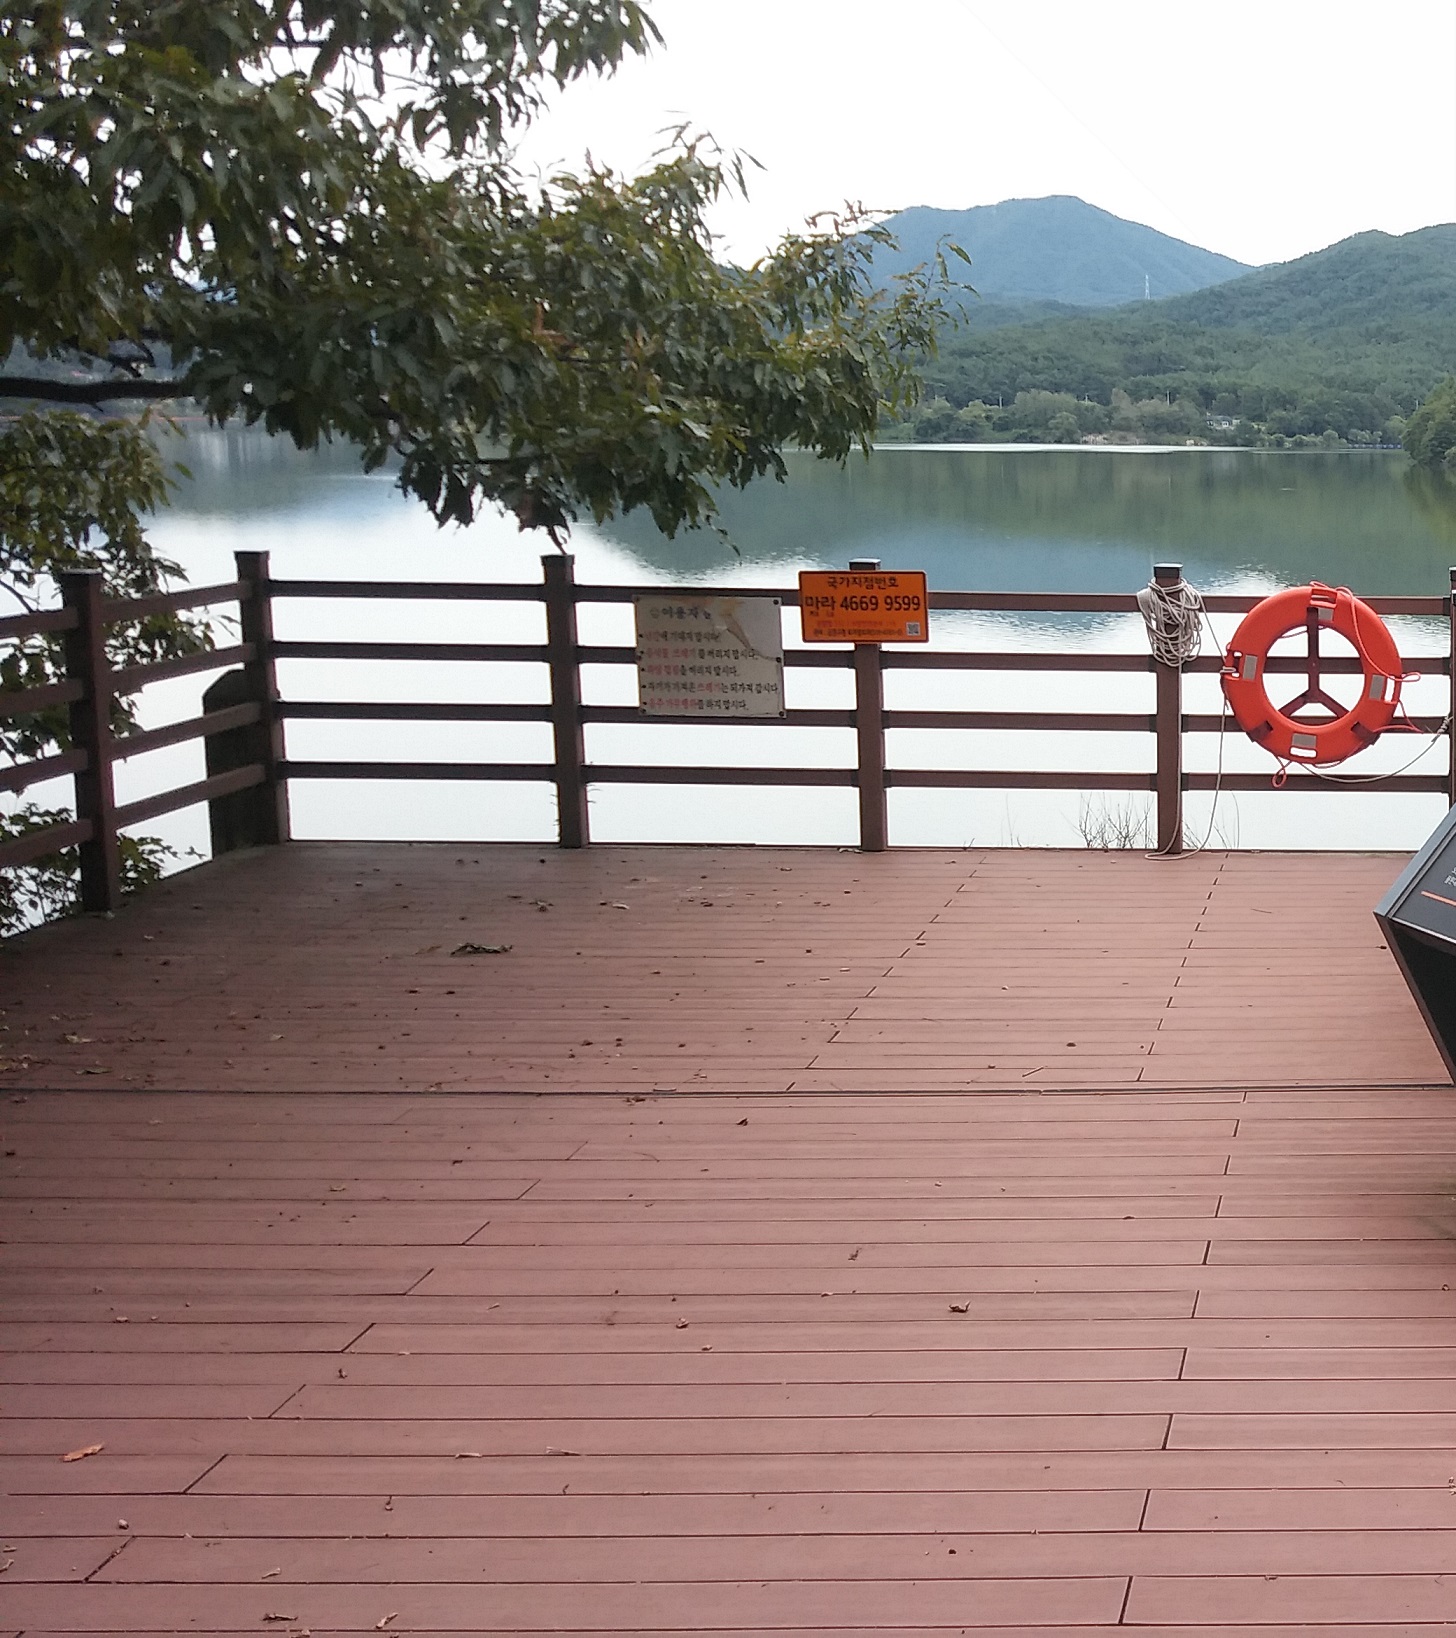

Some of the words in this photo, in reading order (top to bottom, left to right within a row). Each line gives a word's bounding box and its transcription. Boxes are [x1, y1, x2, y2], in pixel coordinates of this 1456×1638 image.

[828, 576, 899, 590] 국가지점번호
[805, 596, 836, 611] 마라
[840, 595, 879, 611] 4669
[884, 595, 921, 611] 9599
